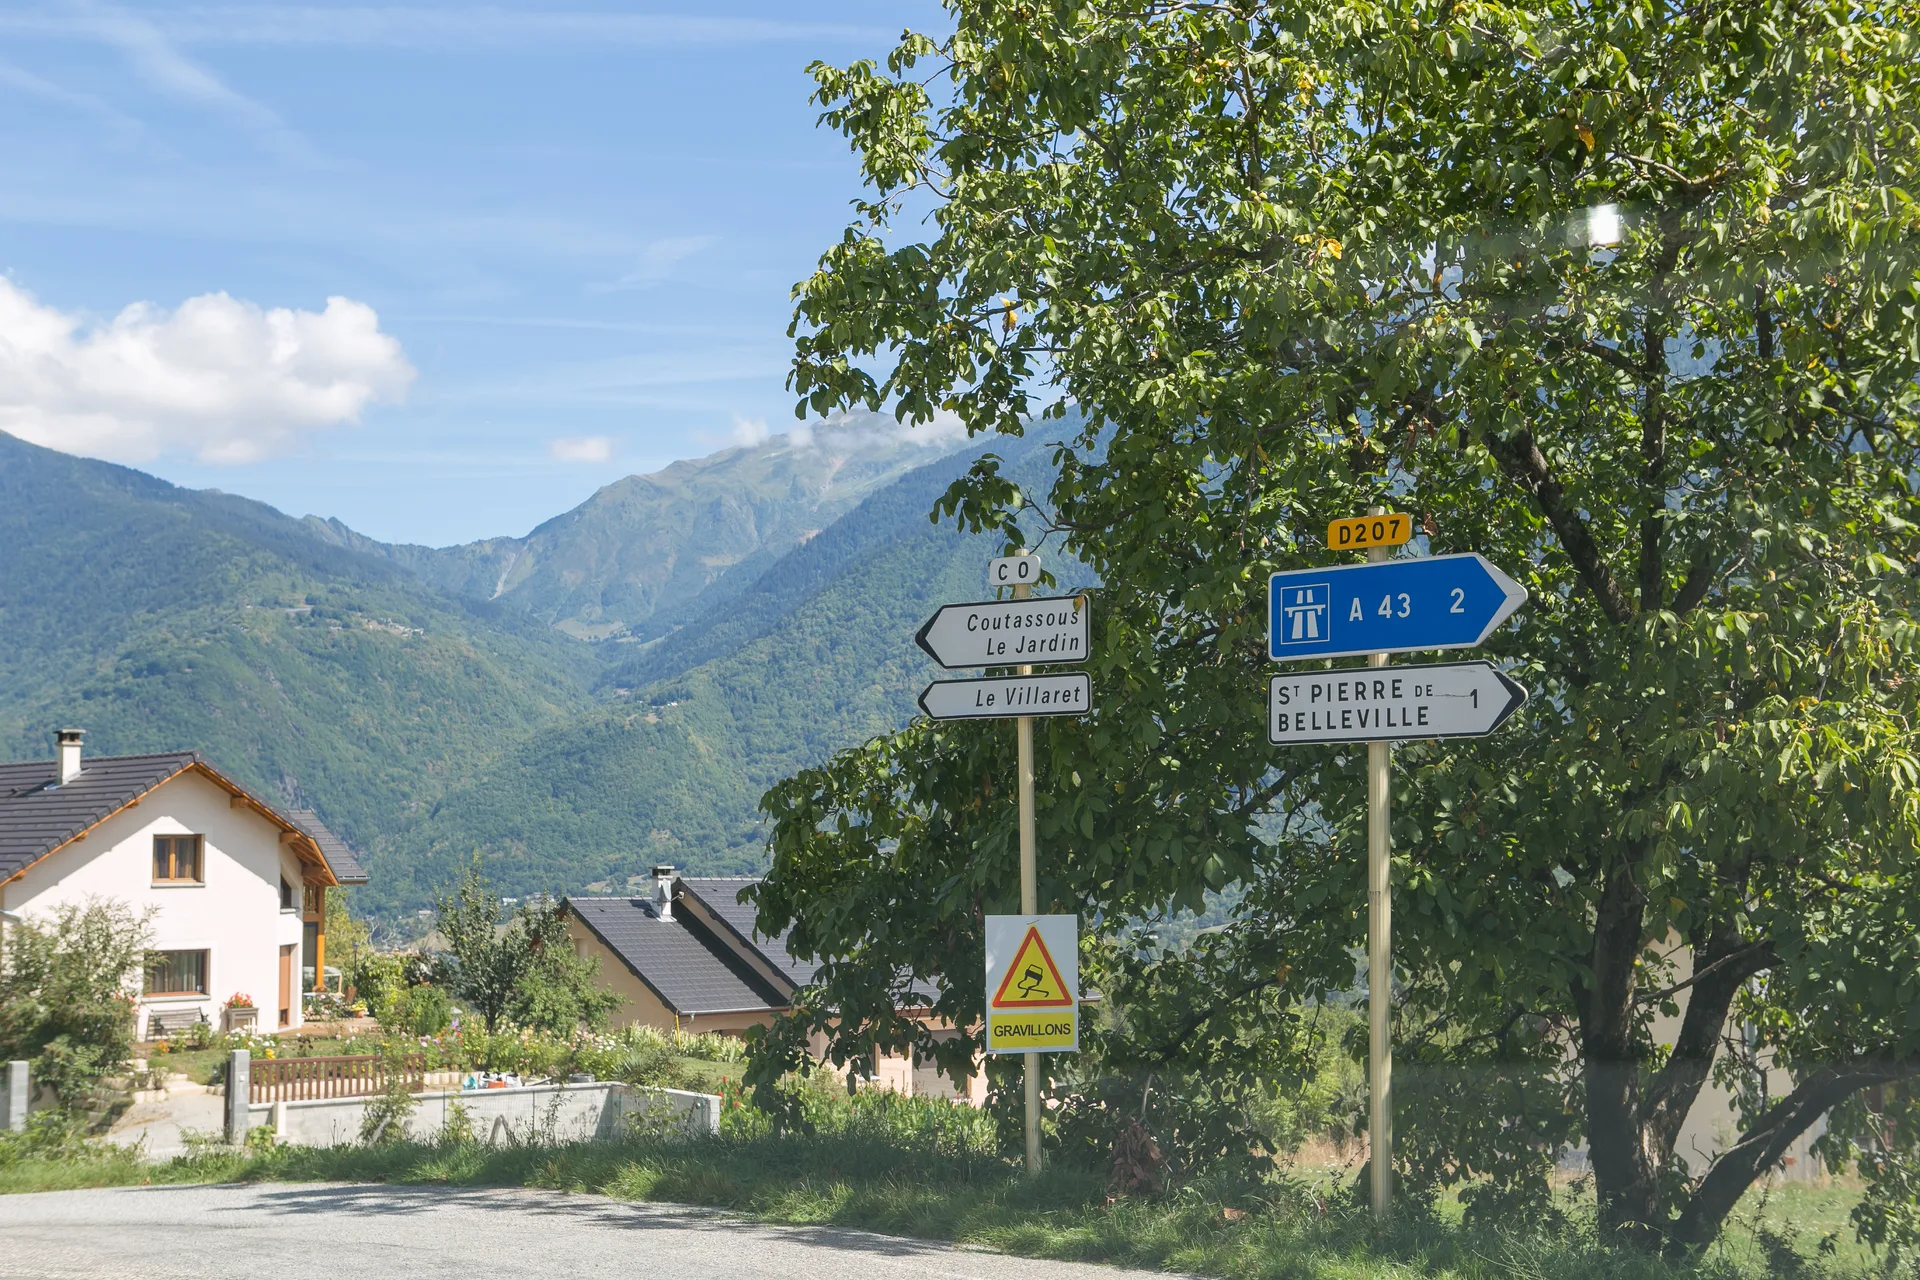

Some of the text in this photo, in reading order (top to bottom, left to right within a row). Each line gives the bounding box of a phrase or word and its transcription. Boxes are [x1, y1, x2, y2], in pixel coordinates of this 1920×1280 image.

[1339, 519, 1401, 545] D207
[1349, 592, 1411, 622] A 43
[1450, 587, 1465, 614] 2
[967, 611, 1079, 632] Coutassous
[986, 633, 1079, 656] Le Jardin
[975, 686, 1080, 707] Le Villaret
[1311, 679, 1403, 704] PIERRE
[1414, 684, 1433, 698] DE
[1470, 688, 1478, 709] 1
[1278, 706, 1429, 733] BELLEVILLE
[994, 1023, 1071, 1037] GRAVILLONS
